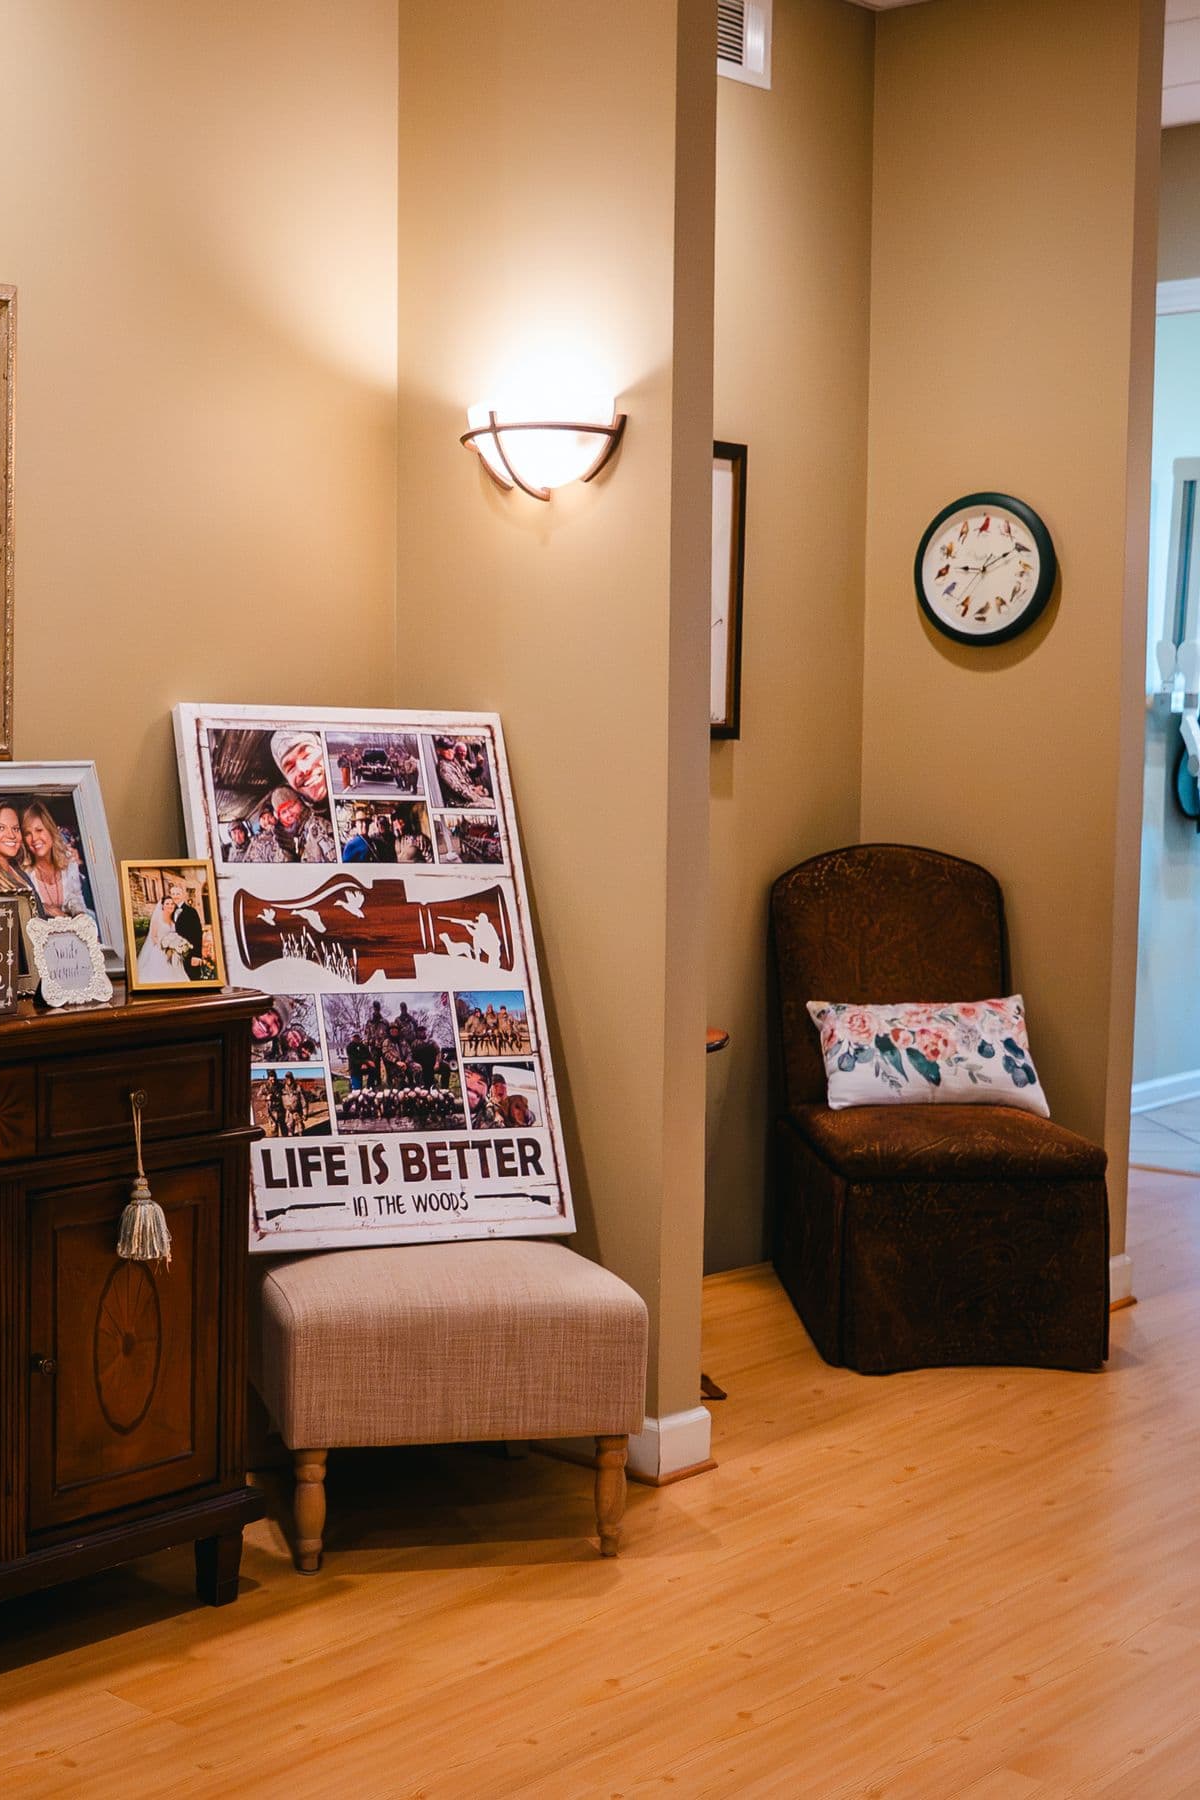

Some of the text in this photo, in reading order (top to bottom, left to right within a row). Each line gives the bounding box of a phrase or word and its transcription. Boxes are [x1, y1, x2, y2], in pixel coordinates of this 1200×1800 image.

[260, 1137, 545, 1189] LIFE IS BETTER
[373, 1195, 407, 1216] THE
[412, 1191, 469, 1213] WOODS
